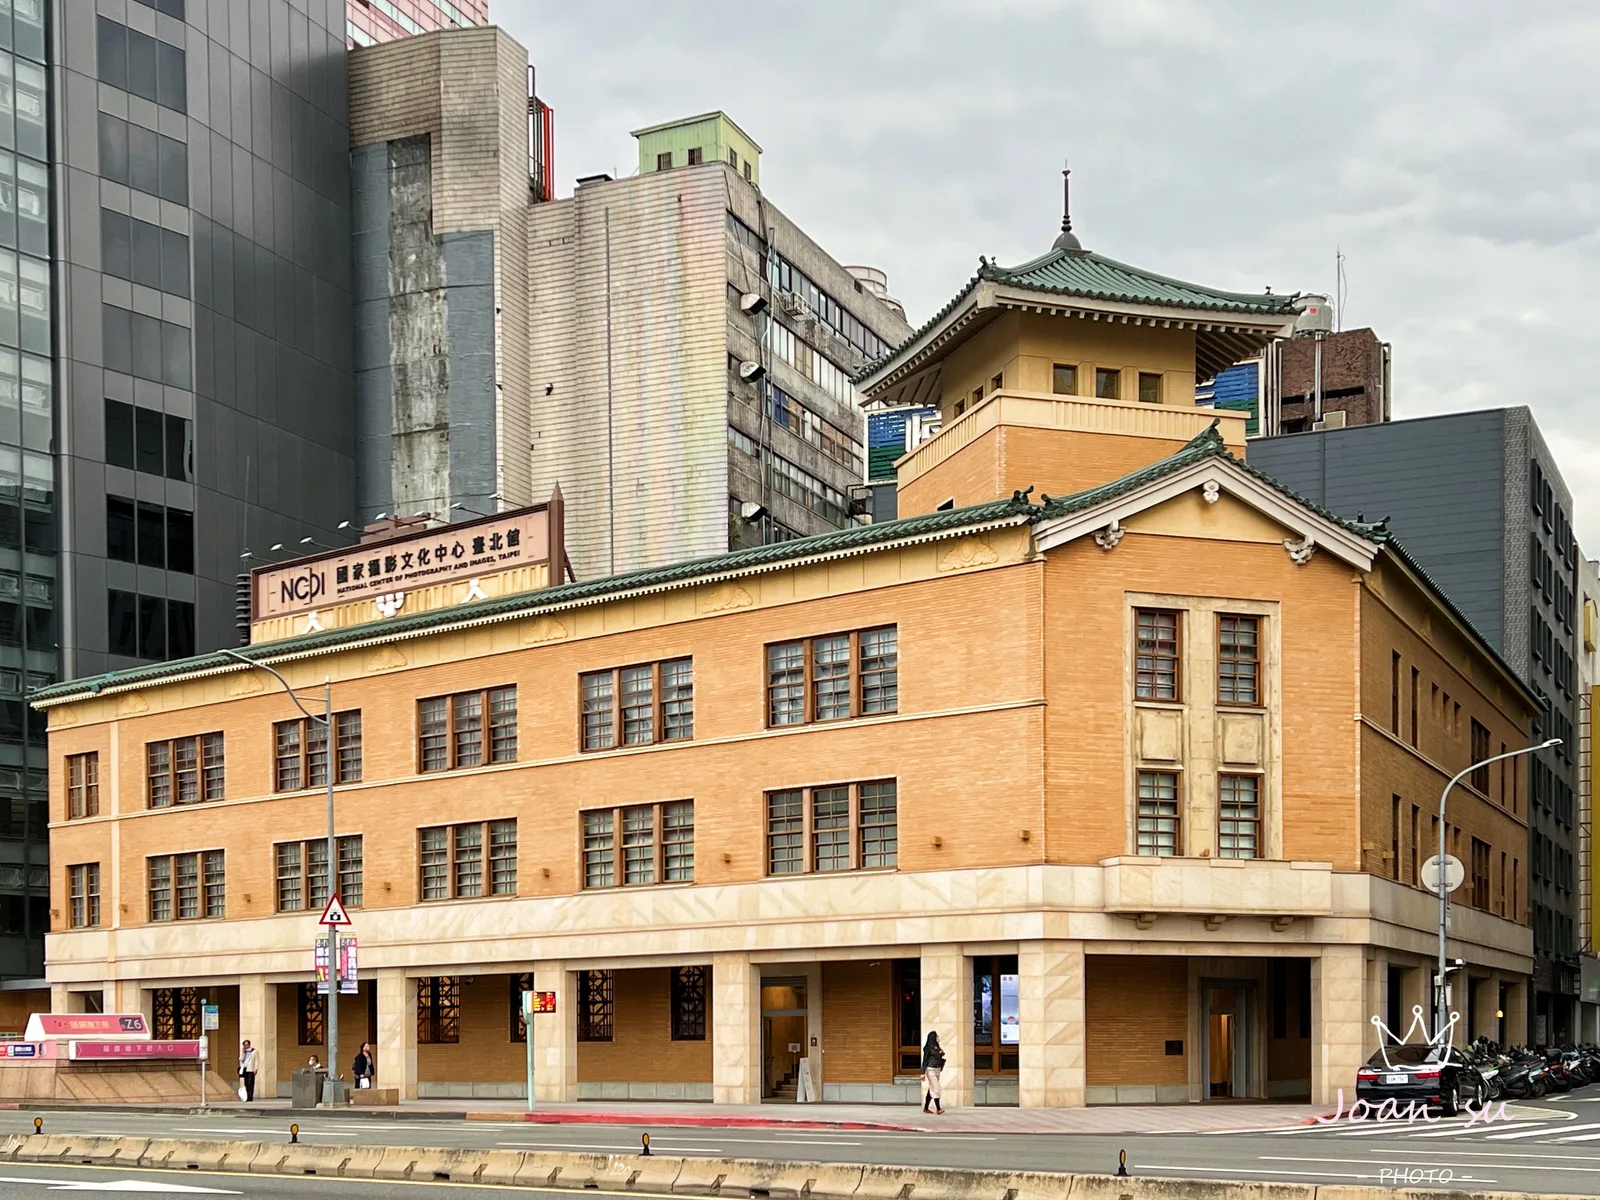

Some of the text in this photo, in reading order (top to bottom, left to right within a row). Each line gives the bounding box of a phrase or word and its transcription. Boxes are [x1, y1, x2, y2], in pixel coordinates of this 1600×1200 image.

[337, 582, 368, 594] NATIONAL
[369, 577, 393, 587] CENTER
[395, 574, 403, 582] OF
[404, 564, 452, 579] PHOTOGRAPHY
[454, 561, 468, 570] AND
[498, 550, 520, 560] TAIPEI
[124, 1019, 142, 1030] Z6
